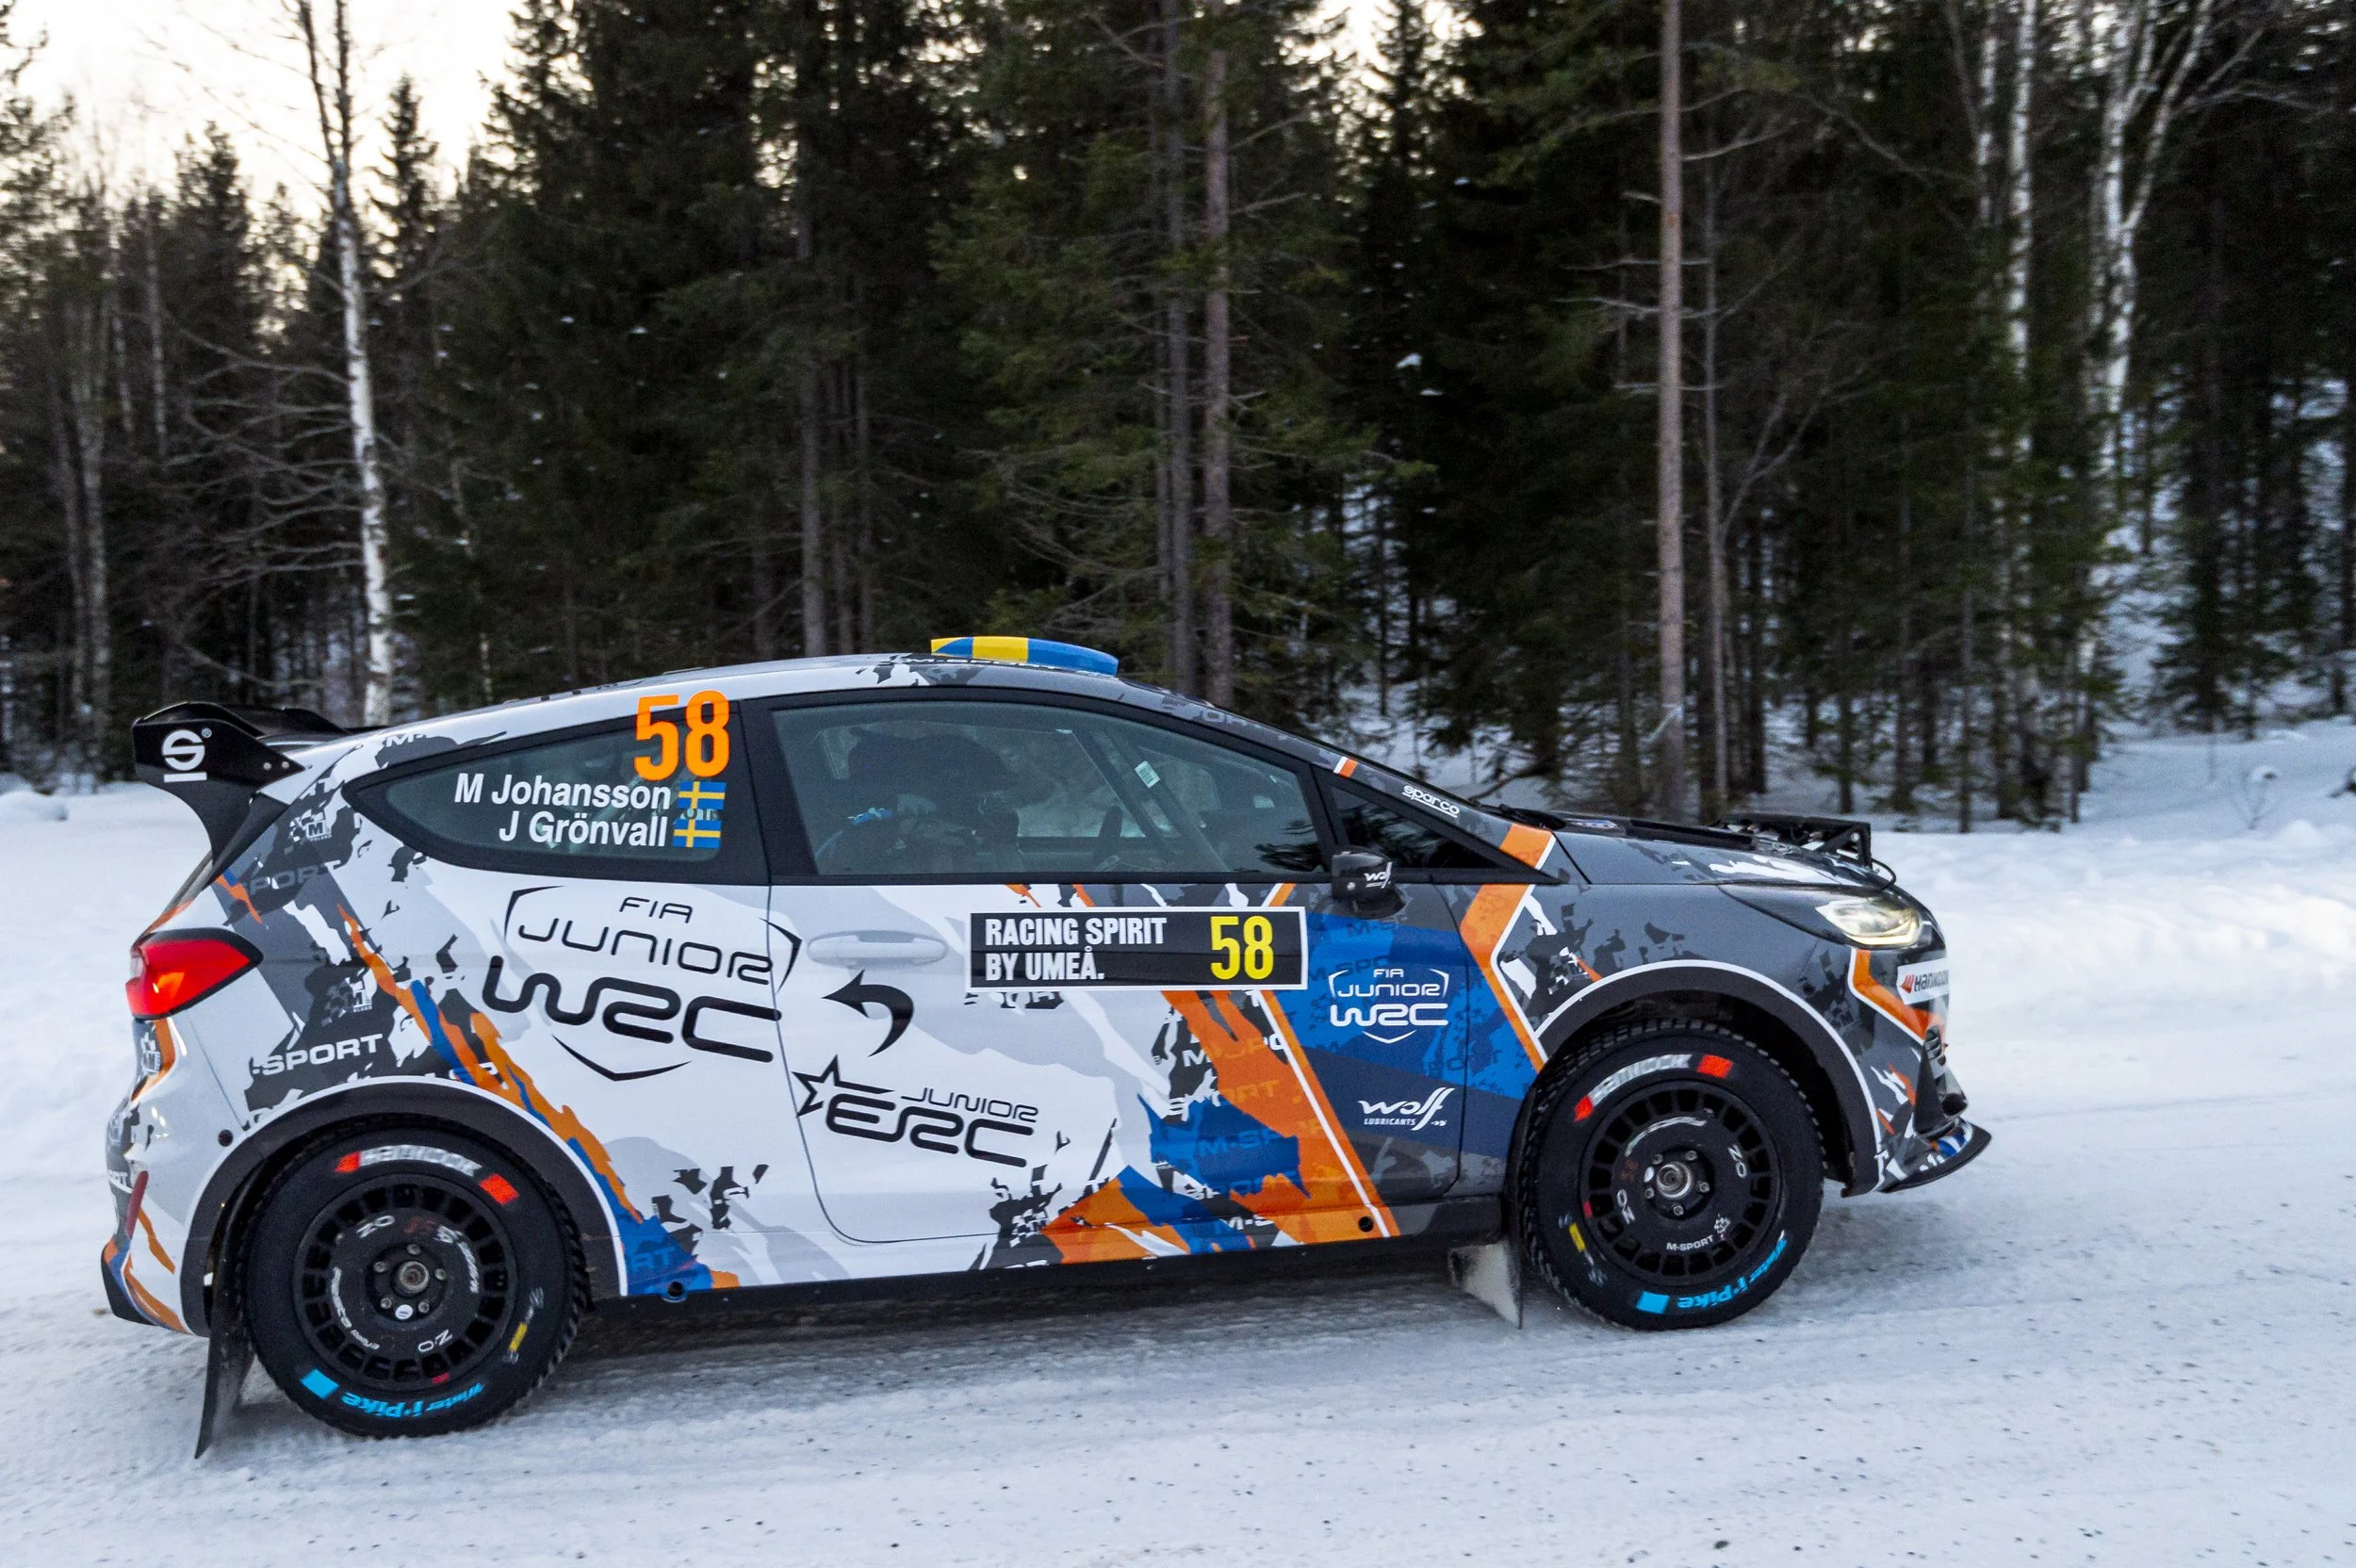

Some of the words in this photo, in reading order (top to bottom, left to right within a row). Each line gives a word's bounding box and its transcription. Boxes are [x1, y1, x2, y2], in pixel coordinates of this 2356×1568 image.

[634, 690, 730, 781] 58
[454, 773, 484, 804] M
[491, 774, 672, 810] Johansson
[1403, 784, 1460, 815] sparco
[499, 810, 521, 841] J
[529, 809, 669, 848] Grönvall
[619, 896, 694, 924] FIA
[985, 917, 1079, 946] RACING
[1085, 917, 1168, 945] SPIRIT
[1210, 915, 1275, 980] 58
[517, 917, 774, 986] JUNIOR
[985, 952, 1016, 982] BY
[1025, 945, 1105, 981] UMEÅ.
[1337, 983, 1441, 998] JUNIOR
[1373, 968, 1404, 978] FIA
[482, 955, 782, 1064] WRC
[1330, 1003, 1449, 1027] WRC
[900, 1086, 1039, 1123] JUNIOR
[1357, 1086, 1455, 1131] wolf
[1364, 1118, 1416, 1126] LUBRICANTS
[825, 1093, 1035, 1168] ERC
[1666, 1234, 1714, 1251] M-SPORT
